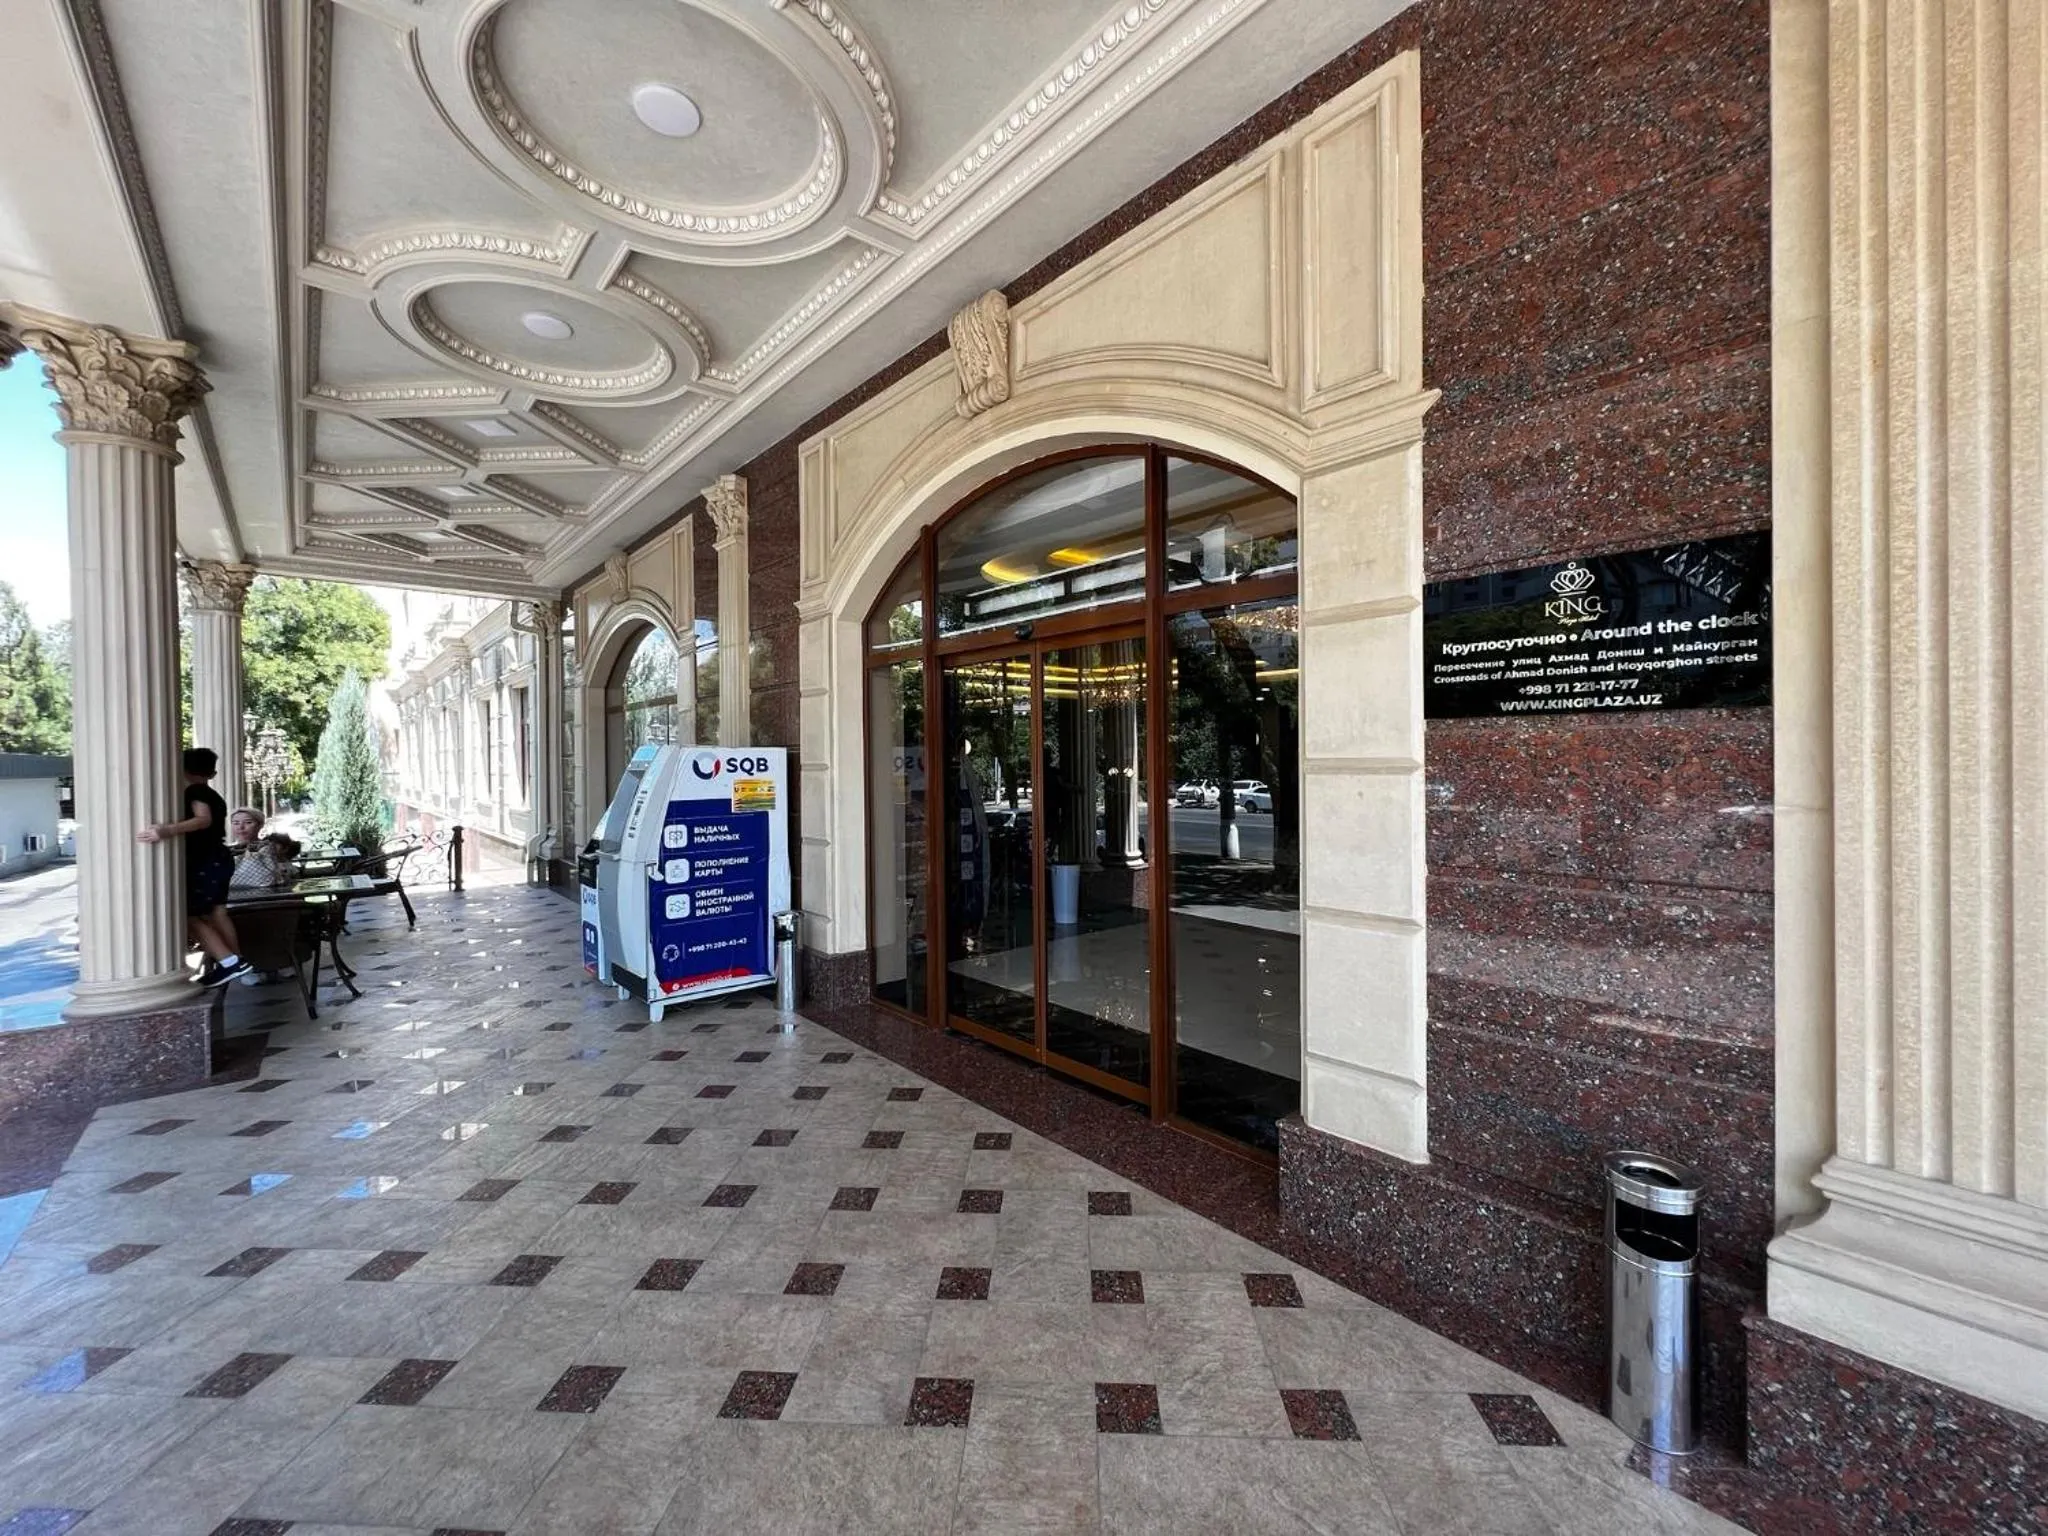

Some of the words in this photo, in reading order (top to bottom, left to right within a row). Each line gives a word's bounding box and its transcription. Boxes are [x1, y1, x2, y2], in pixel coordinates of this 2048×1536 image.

[1544, 596, 1609, 618] KING
[1442, 633, 1567, 657] Круглосуточно
[1581, 621, 1653, 642] Around
[1657, 619, 1693, 634] the
[1698, 611, 1759, 630] clock
[1434, 659, 1506, 674] Пересечение
[1511, 657, 1542, 668] улиц
[1548, 651, 1590, 664] Ахмад
[1596, 647, 1645, 660] Дониш
[1653, 646, 1664, 655] и
[1672, 638, 1758, 653] Майкурган
[1434, 672, 1489, 684] Crossroads
[1490, 670, 1503, 681] of
[1503, 667, 1544, 680] Ahmad
[1546, 664, 1588, 676] Donish
[1590, 660, 1614, 673] and
[1617, 657, 1703, 673] Moyqorghon
[1706, 652, 1758, 665] streets
[1518, 684, 1552, 696] +998
[1554, 683, 1570, 694] 71
[1572, 678, 1639, 693] 221-17-77
[1500, 694, 1663, 711] WWW.KINGPLAZA.UZ
[726, 757, 769, 776] SQB
[693, 825, 729, 835] ВЫДАЧА
[694, 833, 740, 844] НАЛИЧНЫХ
[694, 856, 749, 868] ПОПОЛНЕНИЕ
[694, 868, 723, 878] КАРТЫ
[695, 888, 724, 898] ОБМЕН
[695, 891, 755, 907] ИНОСТРАННОЙ
[695, 905, 732, 917] ВАЛЮТЫ
